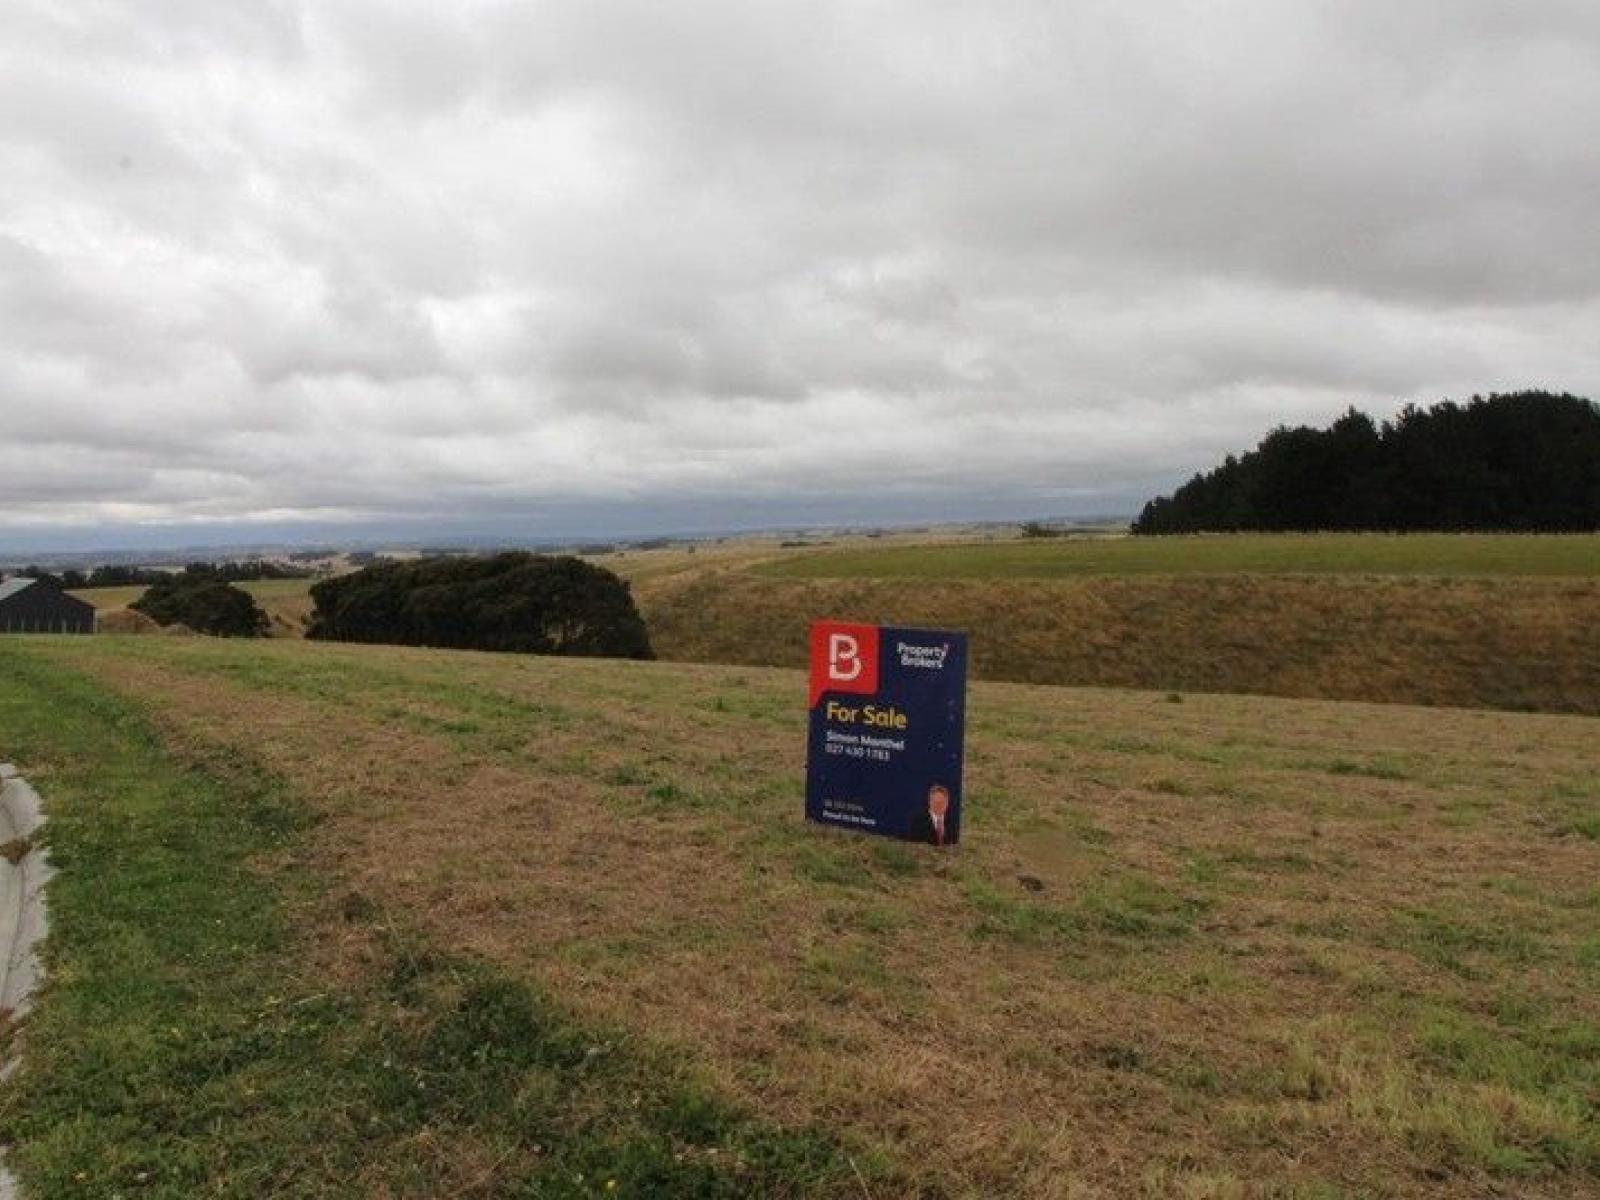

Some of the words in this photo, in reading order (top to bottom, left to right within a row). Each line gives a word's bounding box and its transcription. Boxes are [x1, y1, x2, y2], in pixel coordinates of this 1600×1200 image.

[897, 642, 948, 661] Property
[827, 701, 859, 723] For
[862, 704, 907, 729] Sale
